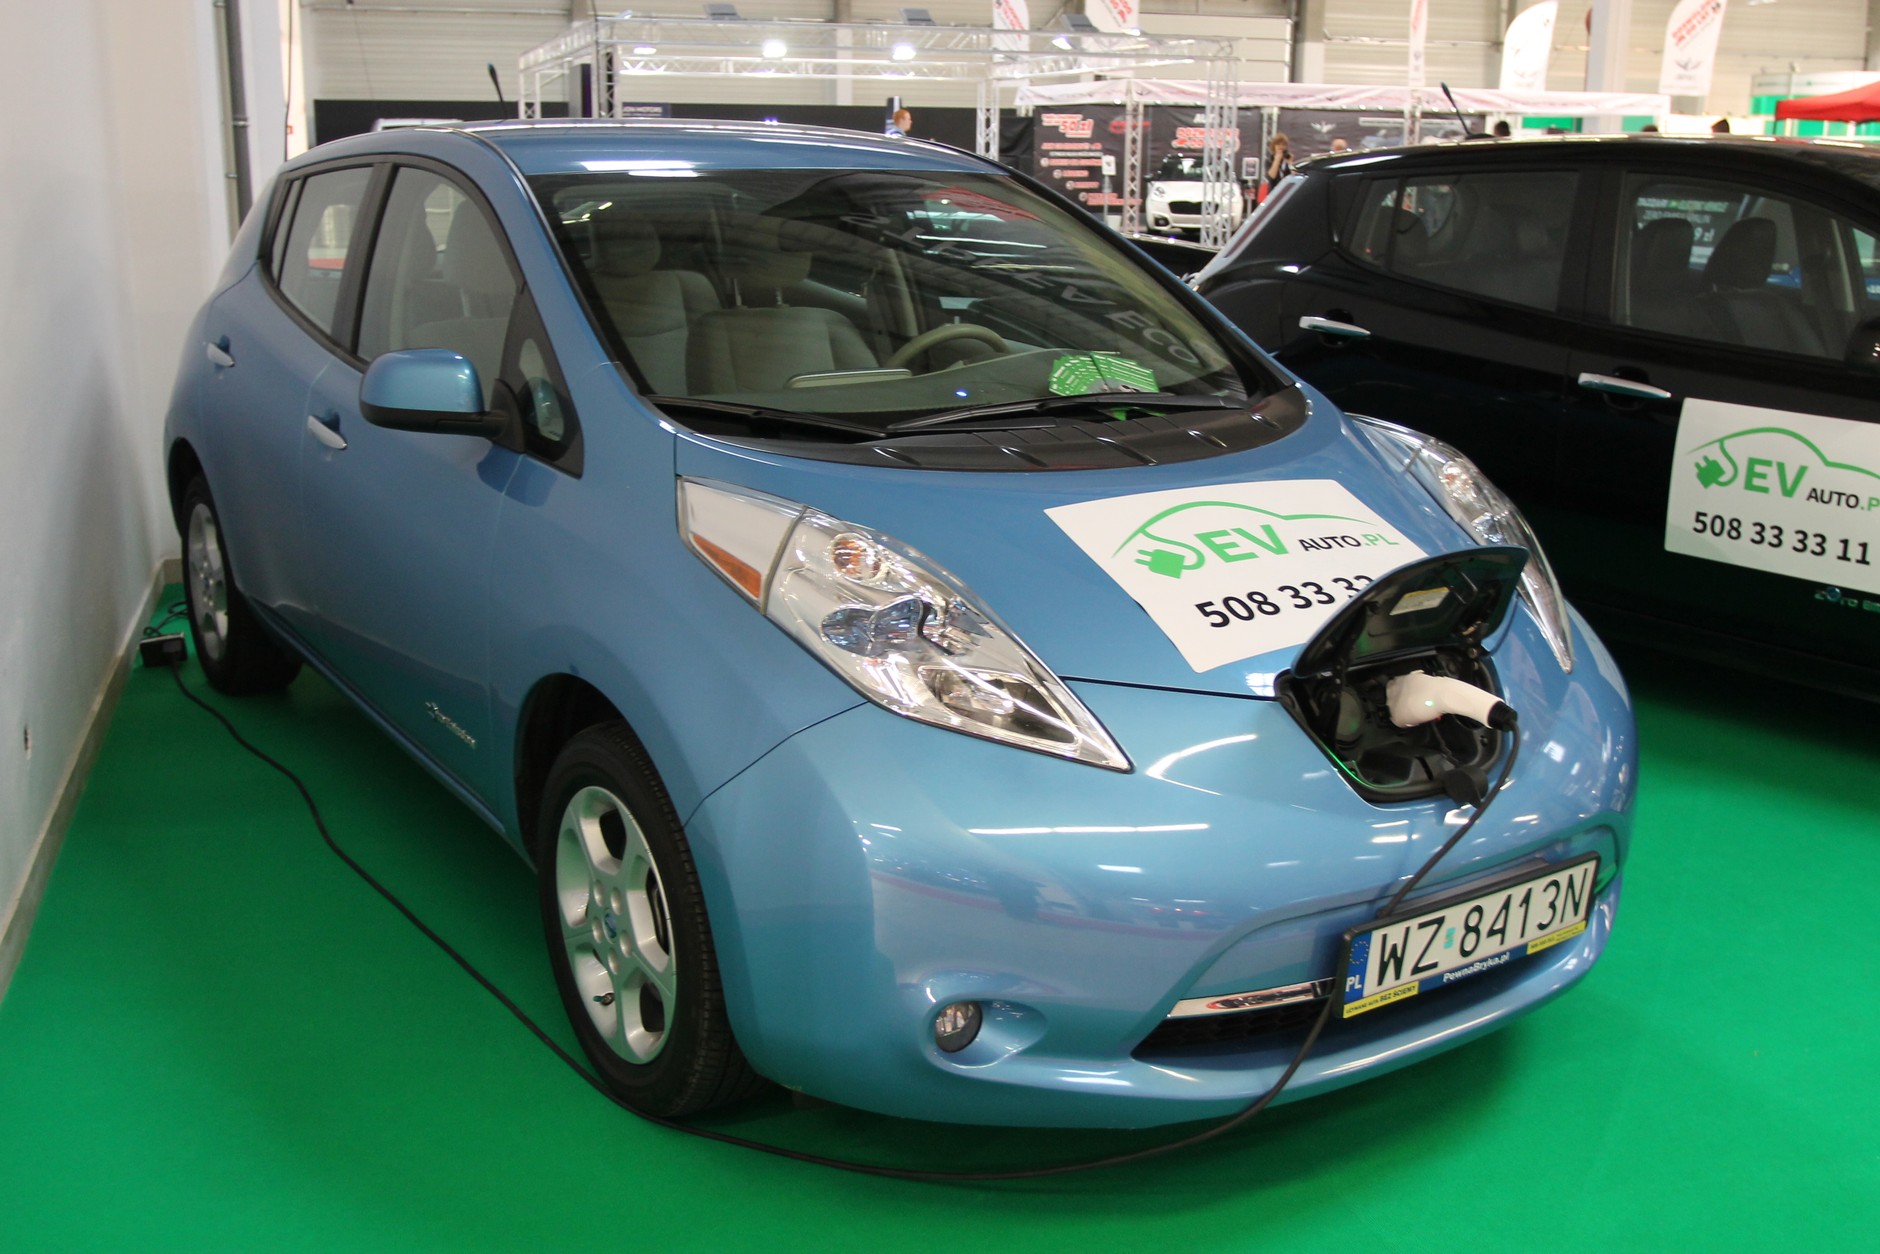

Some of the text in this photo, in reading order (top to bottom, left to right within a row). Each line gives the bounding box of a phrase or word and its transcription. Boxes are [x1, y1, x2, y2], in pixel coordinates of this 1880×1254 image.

[1744, 457, 1809, 498] EV
[1195, 524, 1399, 563] EV AUTO.PL
[1692, 511, 1871, 566] 508 33 33 11
[1195, 591, 1281, 628] 508
[1278, 581, 1336, 609] 33
[1377, 868, 1588, 986] WZ 8413N
[1345, 974, 1363, 992] PL
[1443, 952, 1511, 983] PewnaBryka.pl
